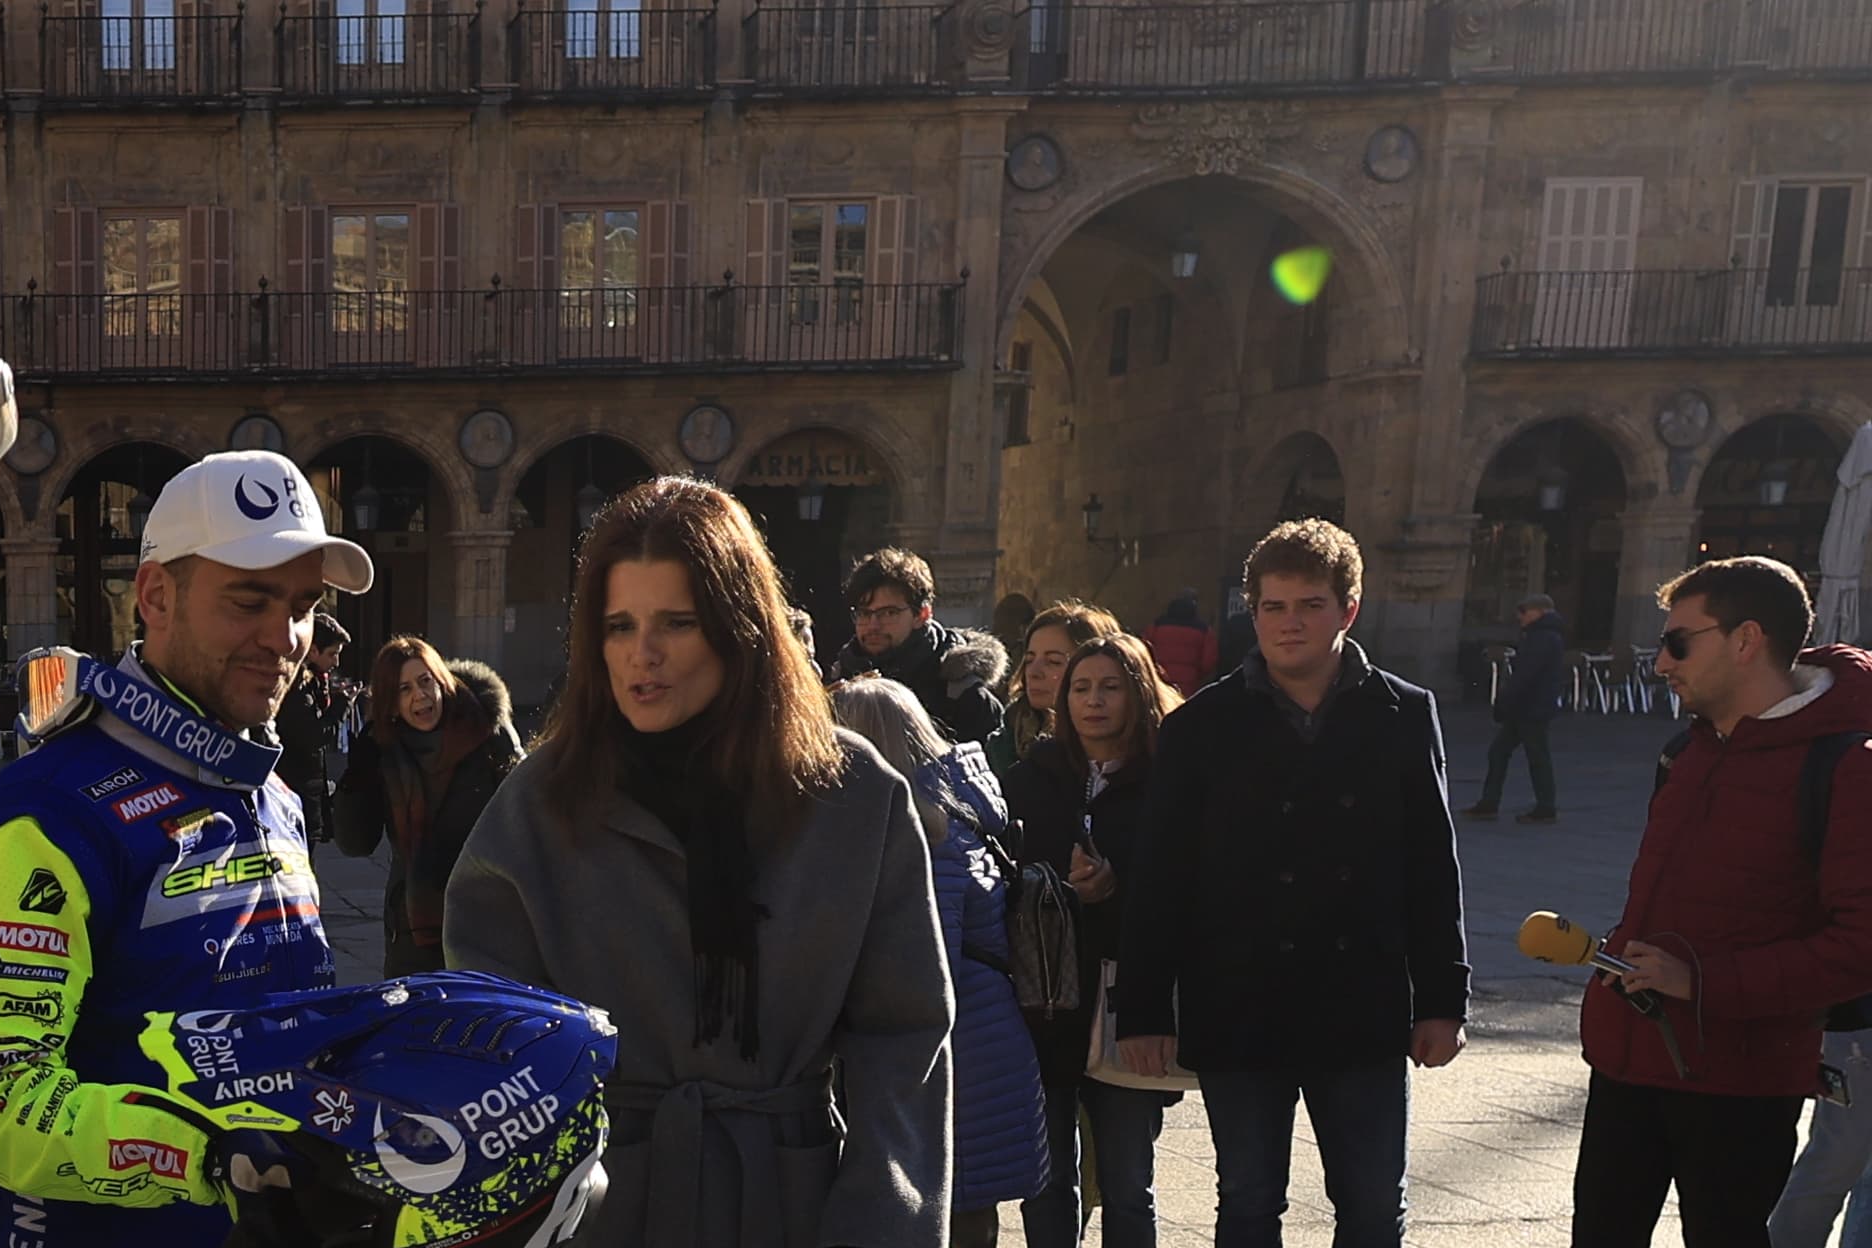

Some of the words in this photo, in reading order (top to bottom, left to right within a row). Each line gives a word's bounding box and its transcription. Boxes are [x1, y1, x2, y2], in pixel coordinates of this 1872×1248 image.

[748, 455, 868, 477] ARMACIA
[115, 683, 181, 738] PONT
[175, 719, 236, 767] GRUP
[90, 768, 140, 797] AIROH
[119, 786, 179, 820] MOTUL
[2, 965, 66, 980] MICHELIN
[2, 999, 51, 1017] AFAM
[188, 1035, 216, 1079] GRUP
[208, 1035, 240, 1075] PONT
[214, 1071, 294, 1101] AIROH
[459, 1065, 541, 1133] PONT
[479, 1094, 559, 1160] GRUP
